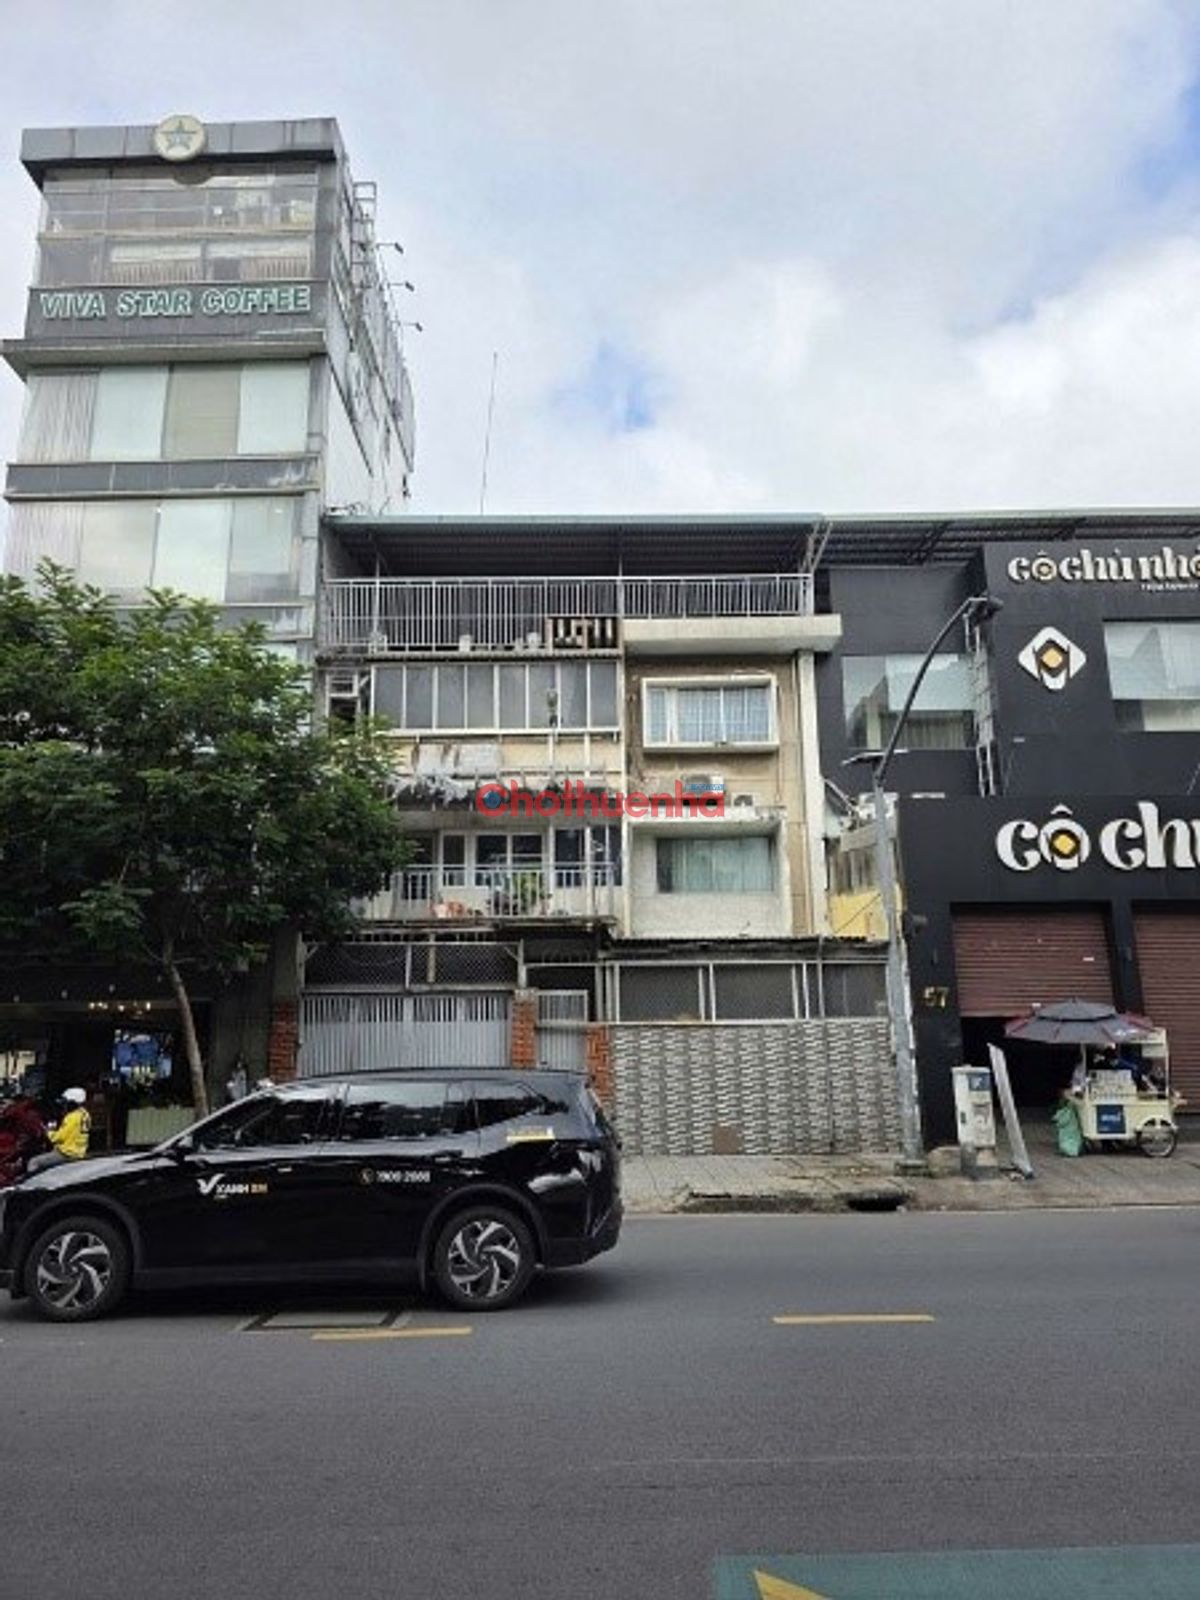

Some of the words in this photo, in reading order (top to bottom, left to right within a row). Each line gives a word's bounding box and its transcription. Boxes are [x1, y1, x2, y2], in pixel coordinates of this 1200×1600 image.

[40, 292, 106, 319] VIVA
[118, 288, 191, 316] STAR
[203, 285, 310, 314] COFFEE
[996, 803, 1091, 870] cô
[1100, 801, 1200, 870] ch
